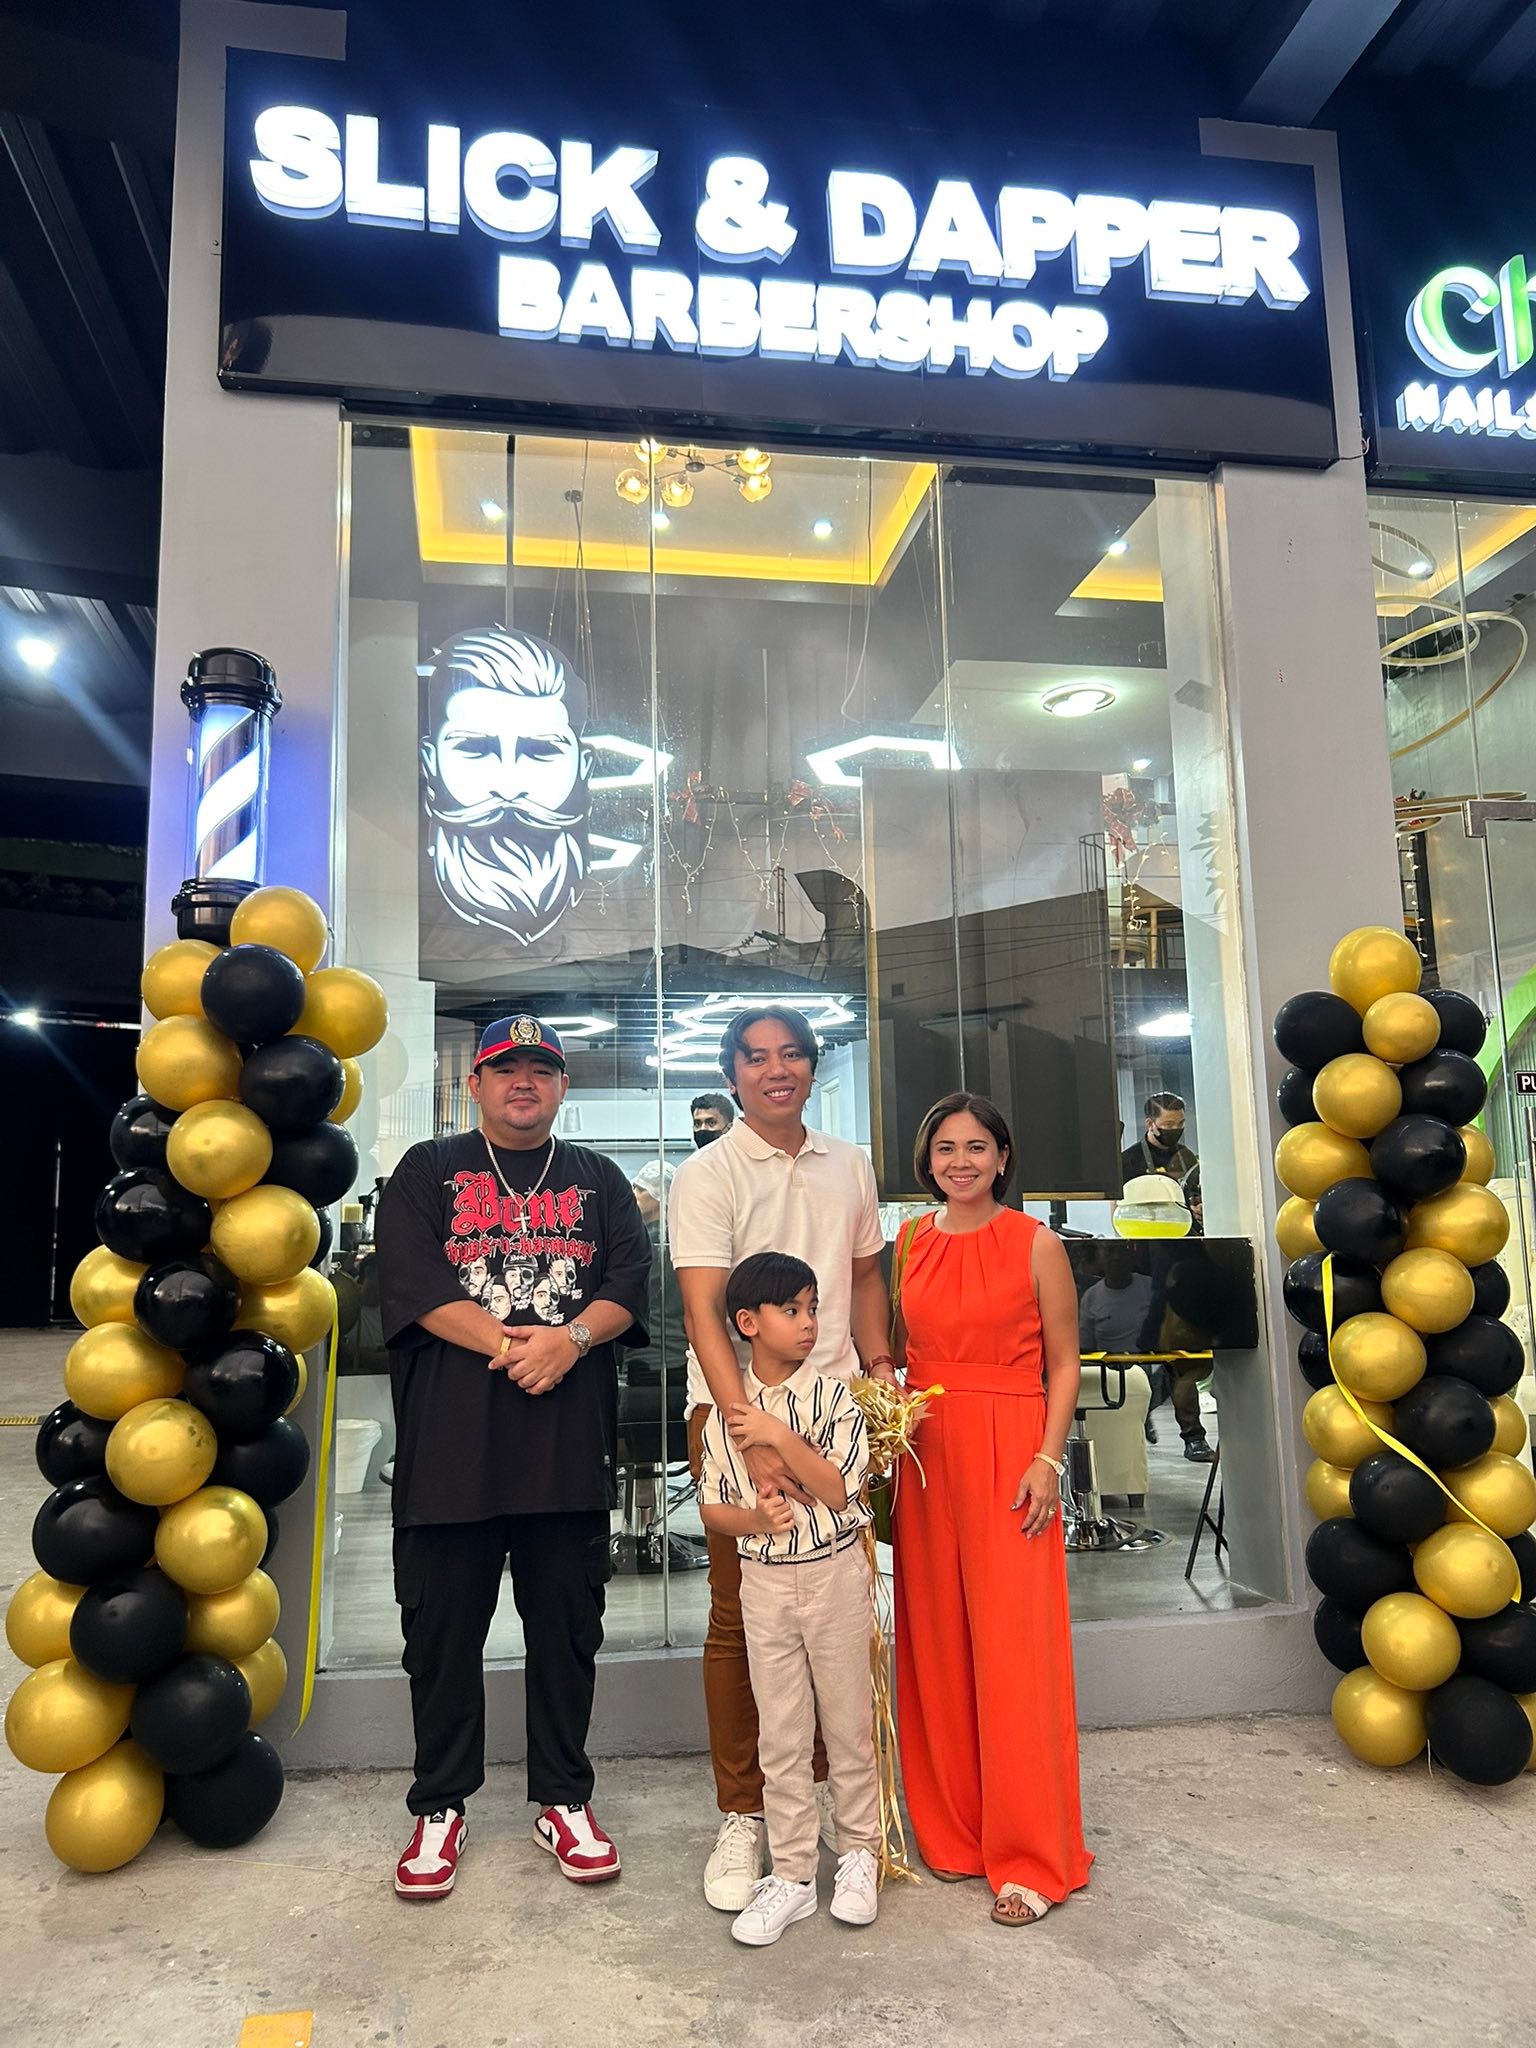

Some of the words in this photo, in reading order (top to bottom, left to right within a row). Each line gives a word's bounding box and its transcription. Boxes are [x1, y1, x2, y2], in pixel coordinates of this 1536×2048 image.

[249, 105, 662, 256] SLICK
[695, 156, 798, 266] &
[827, 168, 1310, 311] DAPPER
[498, 253, 1110, 382] BARBERSHOP
[448, 1170, 590, 1238] Bone
